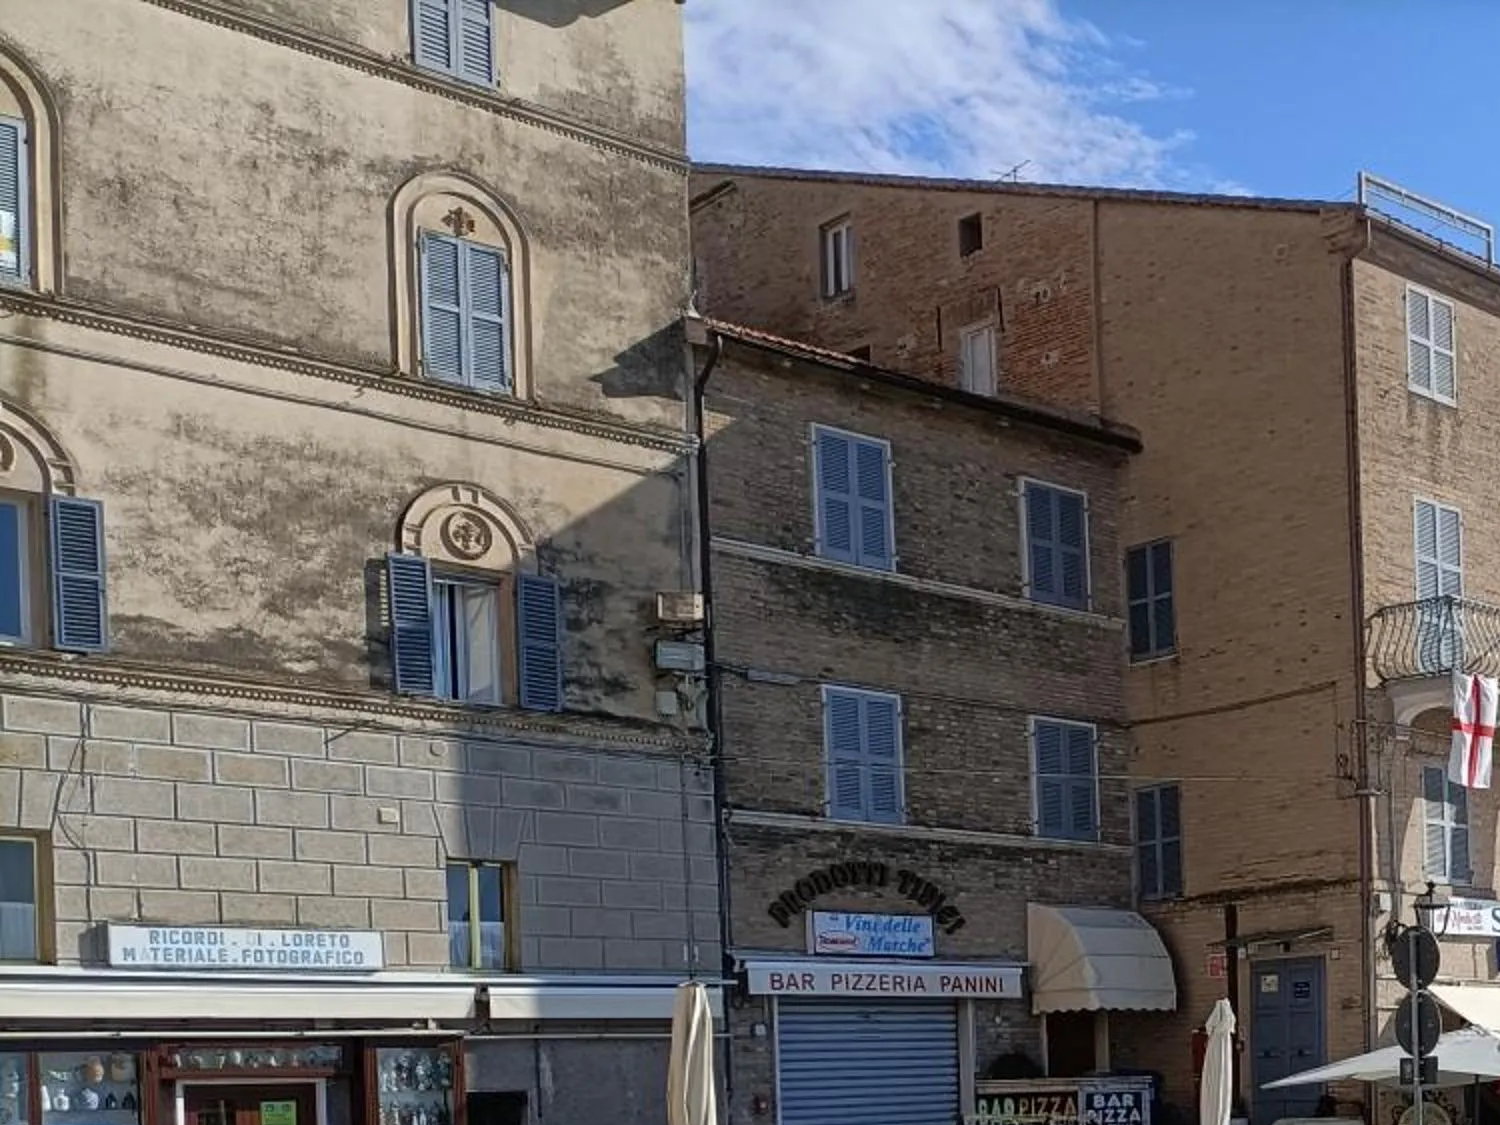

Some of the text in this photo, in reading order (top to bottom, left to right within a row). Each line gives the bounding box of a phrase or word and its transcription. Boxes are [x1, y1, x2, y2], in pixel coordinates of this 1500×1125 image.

[767, 861, 967, 936] PRODOTTI TIPICI
[844, 914, 922, 934] Vini delle
[149, 929, 225, 947] RICORDI
[281, 933, 350, 948] LORETO
[241, 949, 365, 965] FOTOGRAFICO
[769, 972, 1005, 994] BAR PIZZERIA PANINI
[1019, 1095, 1077, 1118] PIZZA
[1093, 1093, 1134, 1108] BAR
[1087, 1108, 1142, 1124] PIZZA
